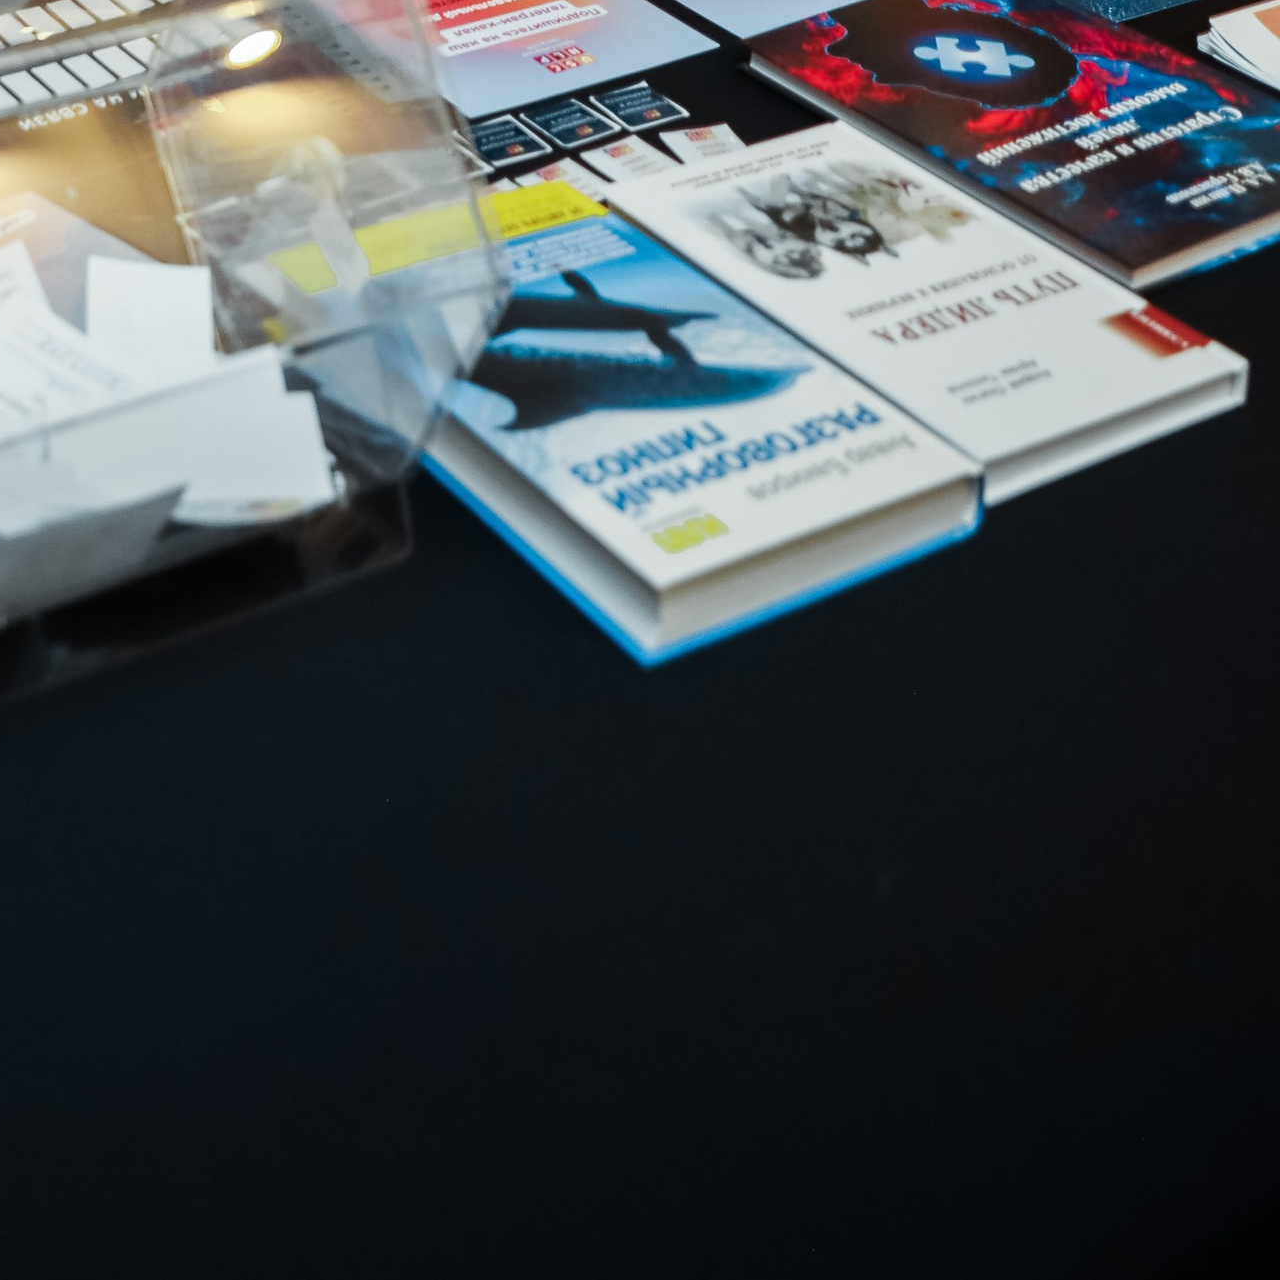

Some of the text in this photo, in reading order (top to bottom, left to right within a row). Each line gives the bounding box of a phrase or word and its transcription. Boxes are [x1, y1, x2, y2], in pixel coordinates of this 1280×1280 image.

[445, 6, 601, 53] Подпишитесь на наш
[451, 3, 566, 35] телеграм-канал
[1129, 102, 1244, 151] Стратегии
[1016, 149, 1119, 193] качества
[567, 418, 729, 489] ГИПНОЗ
[598, 401, 885, 520] РАЗГОВОРНЫЙ
